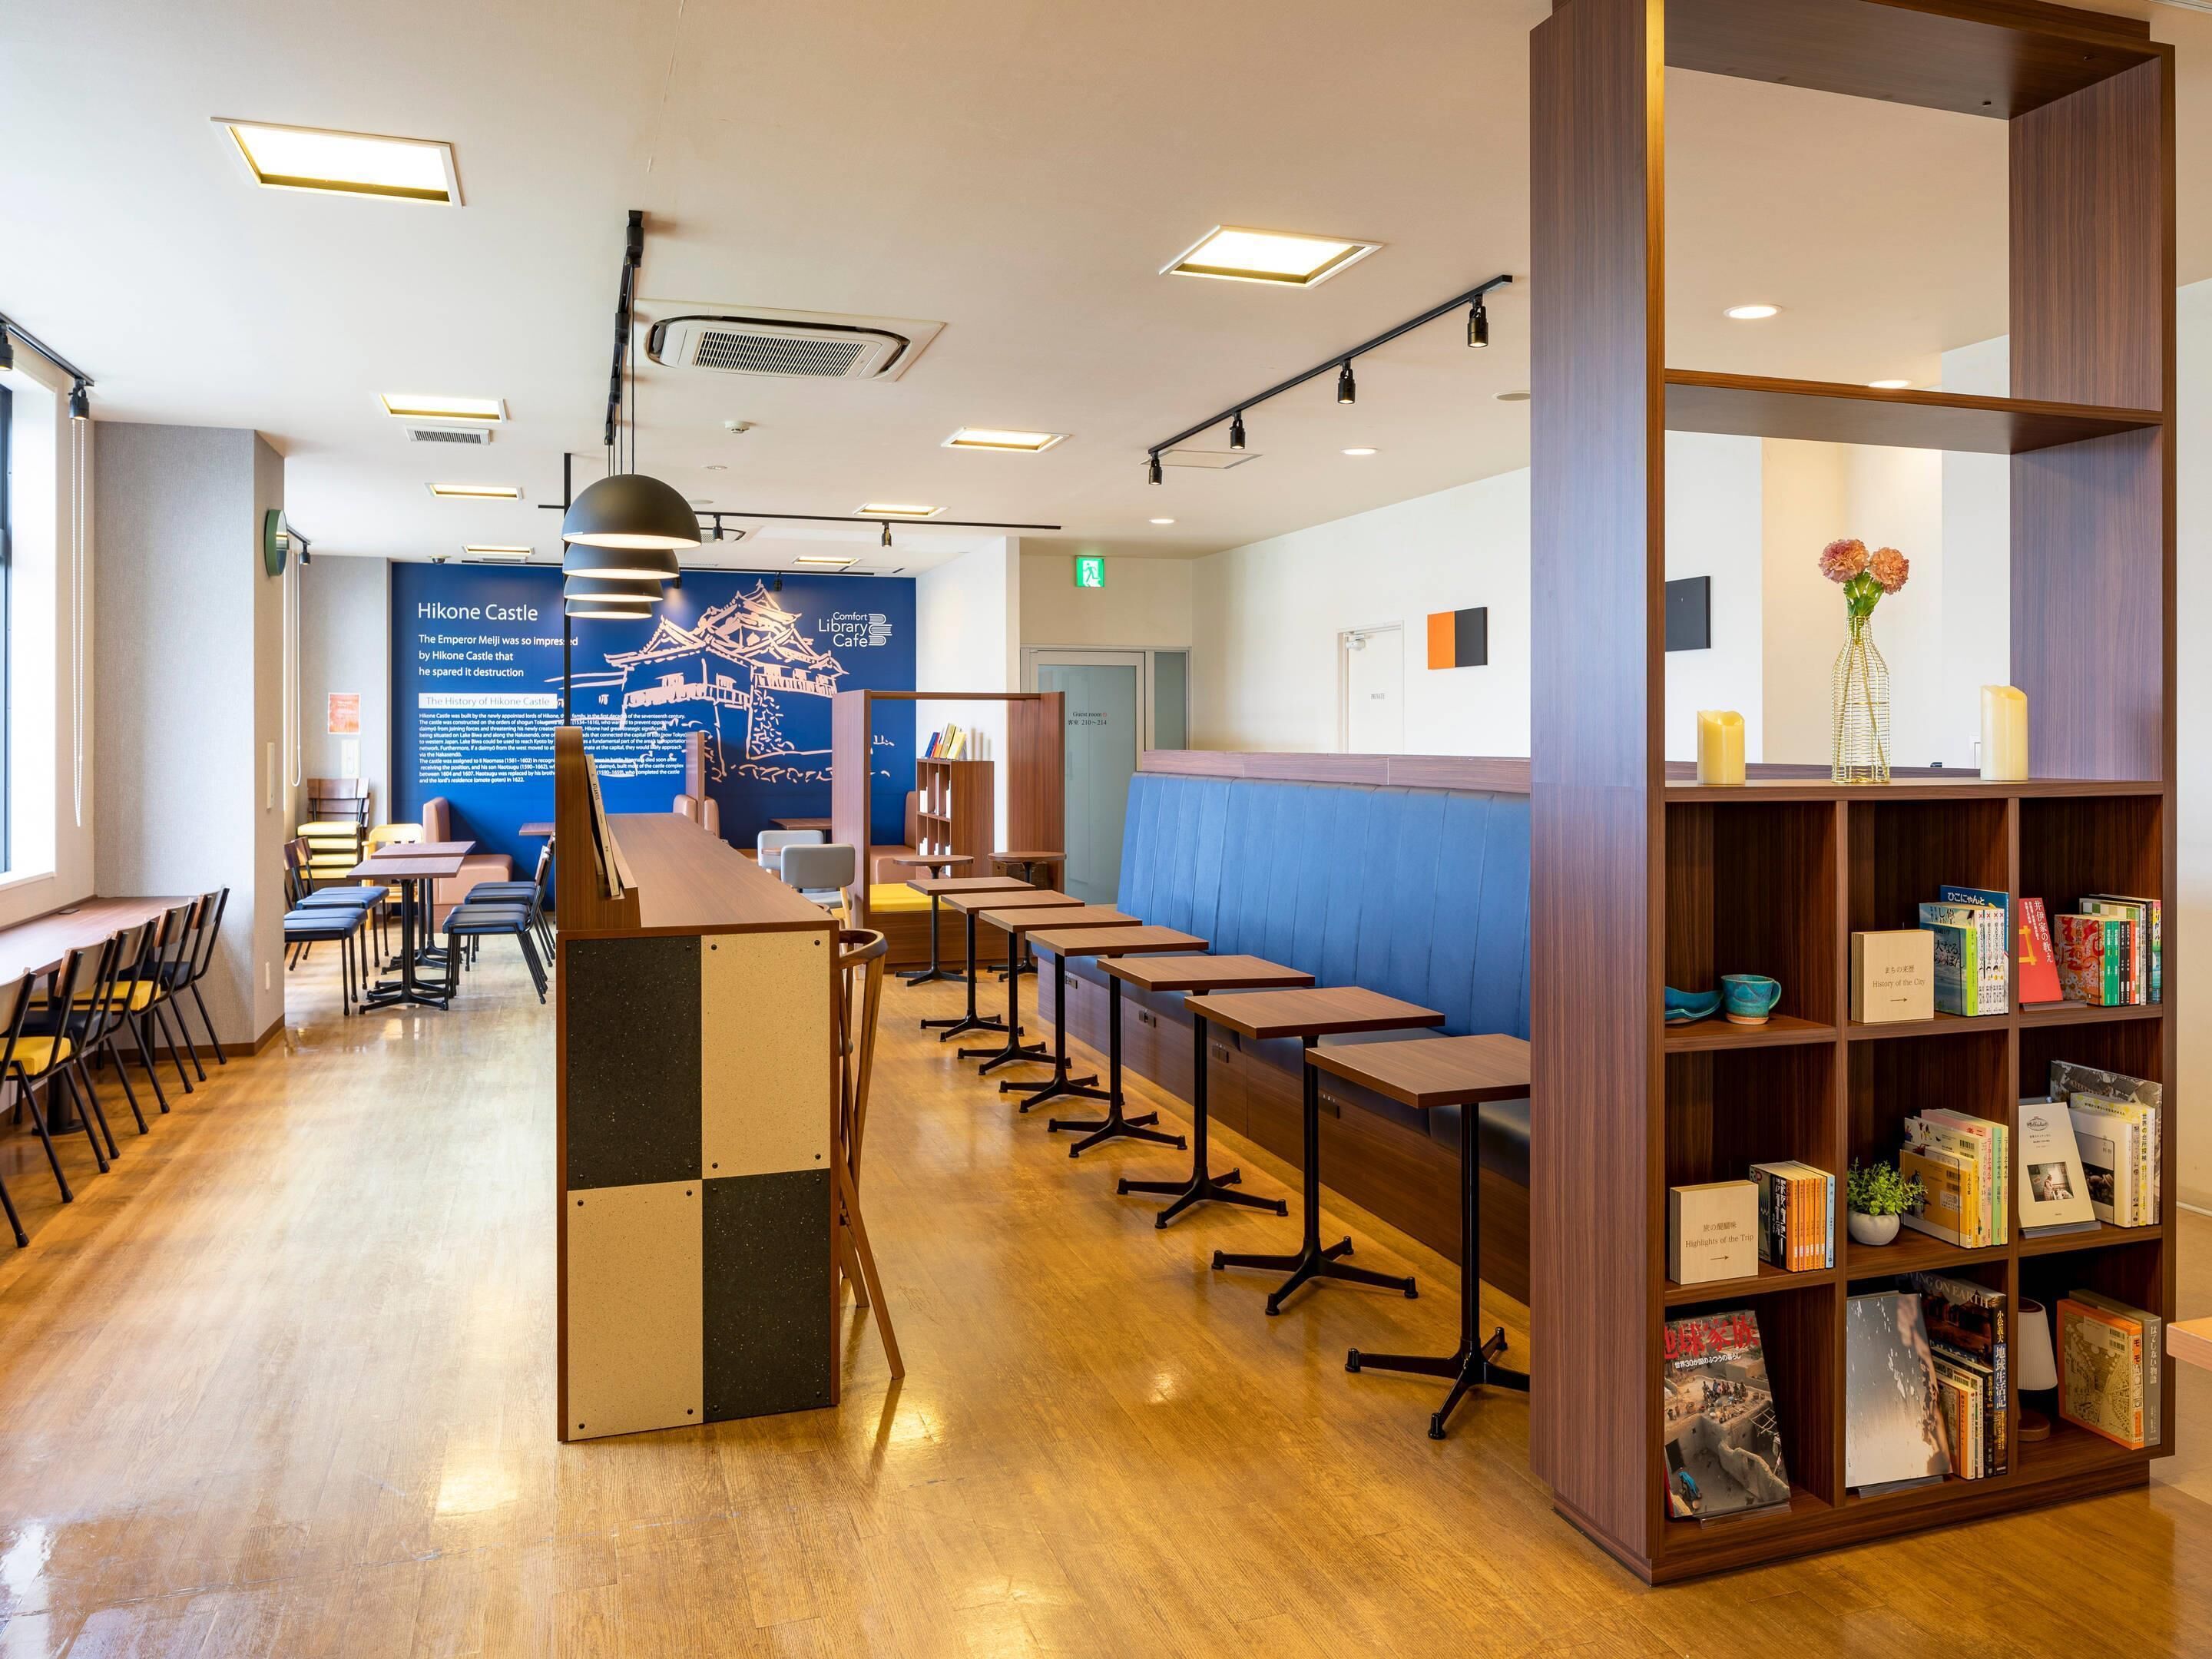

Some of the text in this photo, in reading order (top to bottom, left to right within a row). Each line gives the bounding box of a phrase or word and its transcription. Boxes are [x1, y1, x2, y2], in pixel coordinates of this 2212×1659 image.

[418, 602, 538, 621] Hikone Castle
[833, 611, 867, 621] Comfort
[819, 618, 868, 637] Library
[419, 634, 436, 645] The
[438, 634, 477, 647] Emperor
[478, 635, 500, 647] Meiji
[533, 636, 578, 647] impresd
[833, 633, 868, 647] Cafe
[419, 651, 513, 661] by Hikone Castle that
[419, 667, 429, 676] he
[432, 667, 462, 677] spared
[473, 667, 524, 677] destruction
[427, 697, 550, 707] The History of Hikone Castle
[1948, 892, 1985, 906] ひこにゃんと
[2034, 900, 2053, 963] 井伊家の教え
[1873, 980, 1894, 988] History
[1914, 978, 1926, 986] City
[1685, 1238, 1718, 1248] Highlights
[1740, 1233, 1754, 1243] Trip
[1936, 1279, 1951, 1293] ON
[1952, 1286, 1989, 1310] EARTH
[1665, 1315, 1759, 1359] 地球家族
[1995, 1346, 2006, 1409] 地球生活記
